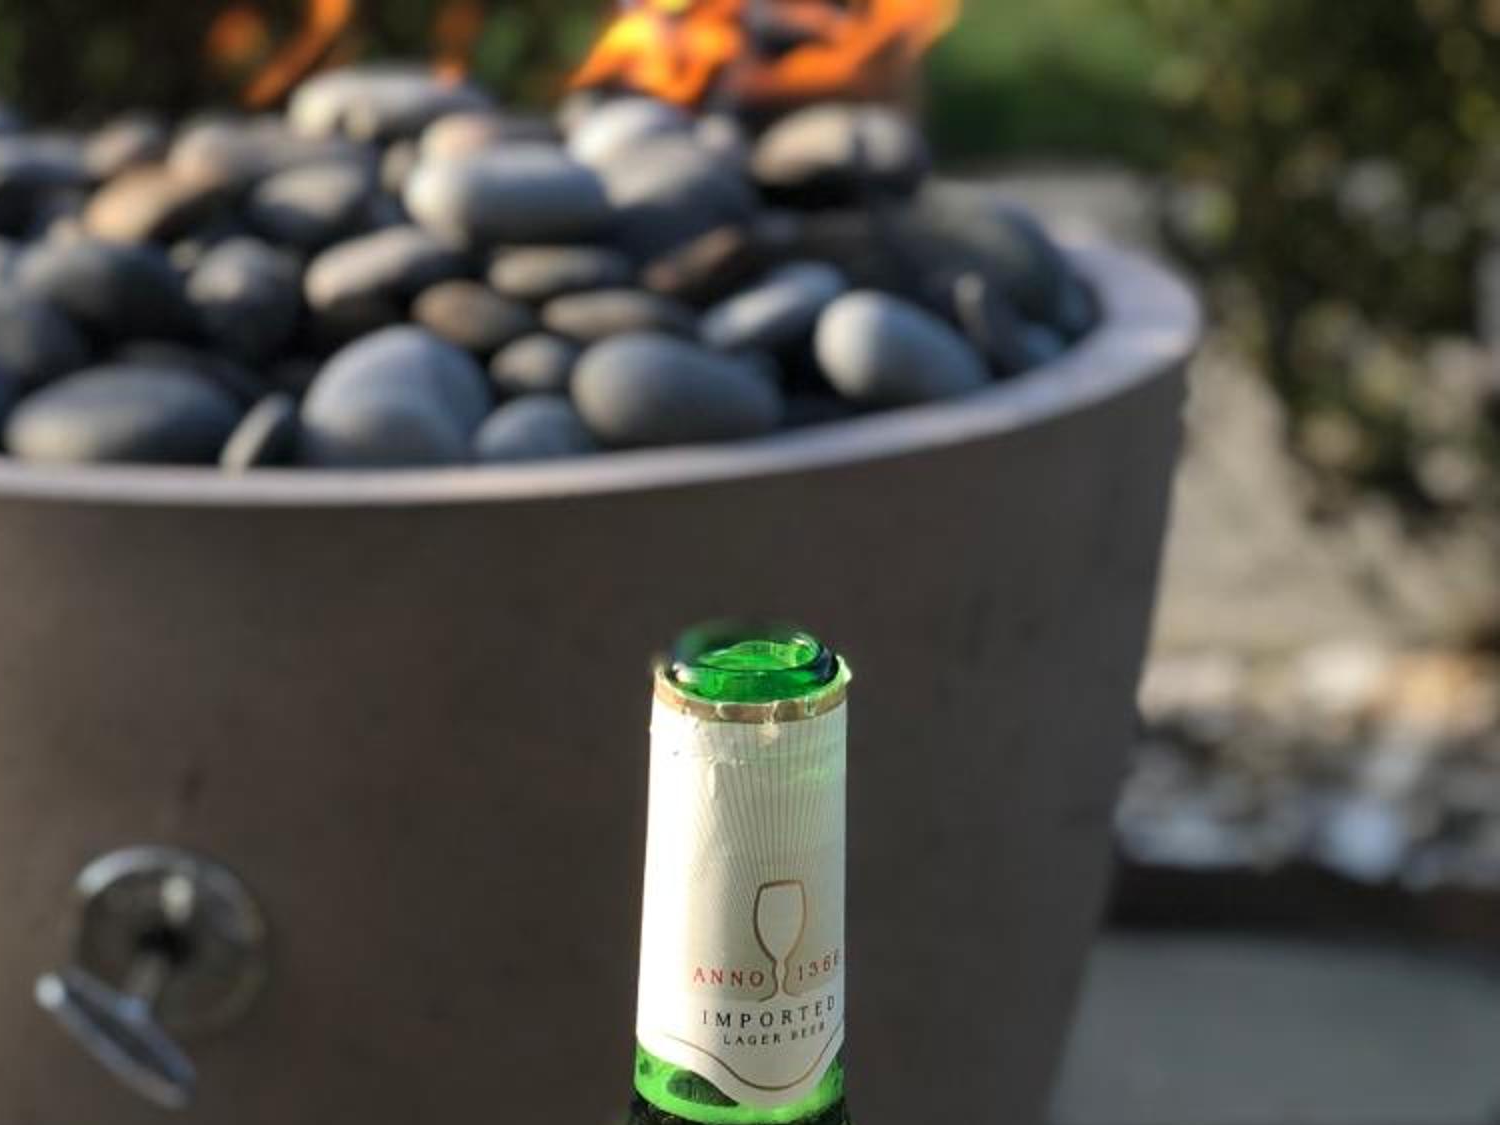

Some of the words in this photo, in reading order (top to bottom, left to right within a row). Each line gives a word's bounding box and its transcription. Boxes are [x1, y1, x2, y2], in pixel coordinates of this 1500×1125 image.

[692, 966, 765, 988] ANNO
[703, 996, 836, 1029] IMPORTED
[723, 1032, 782, 1046] LAGER
